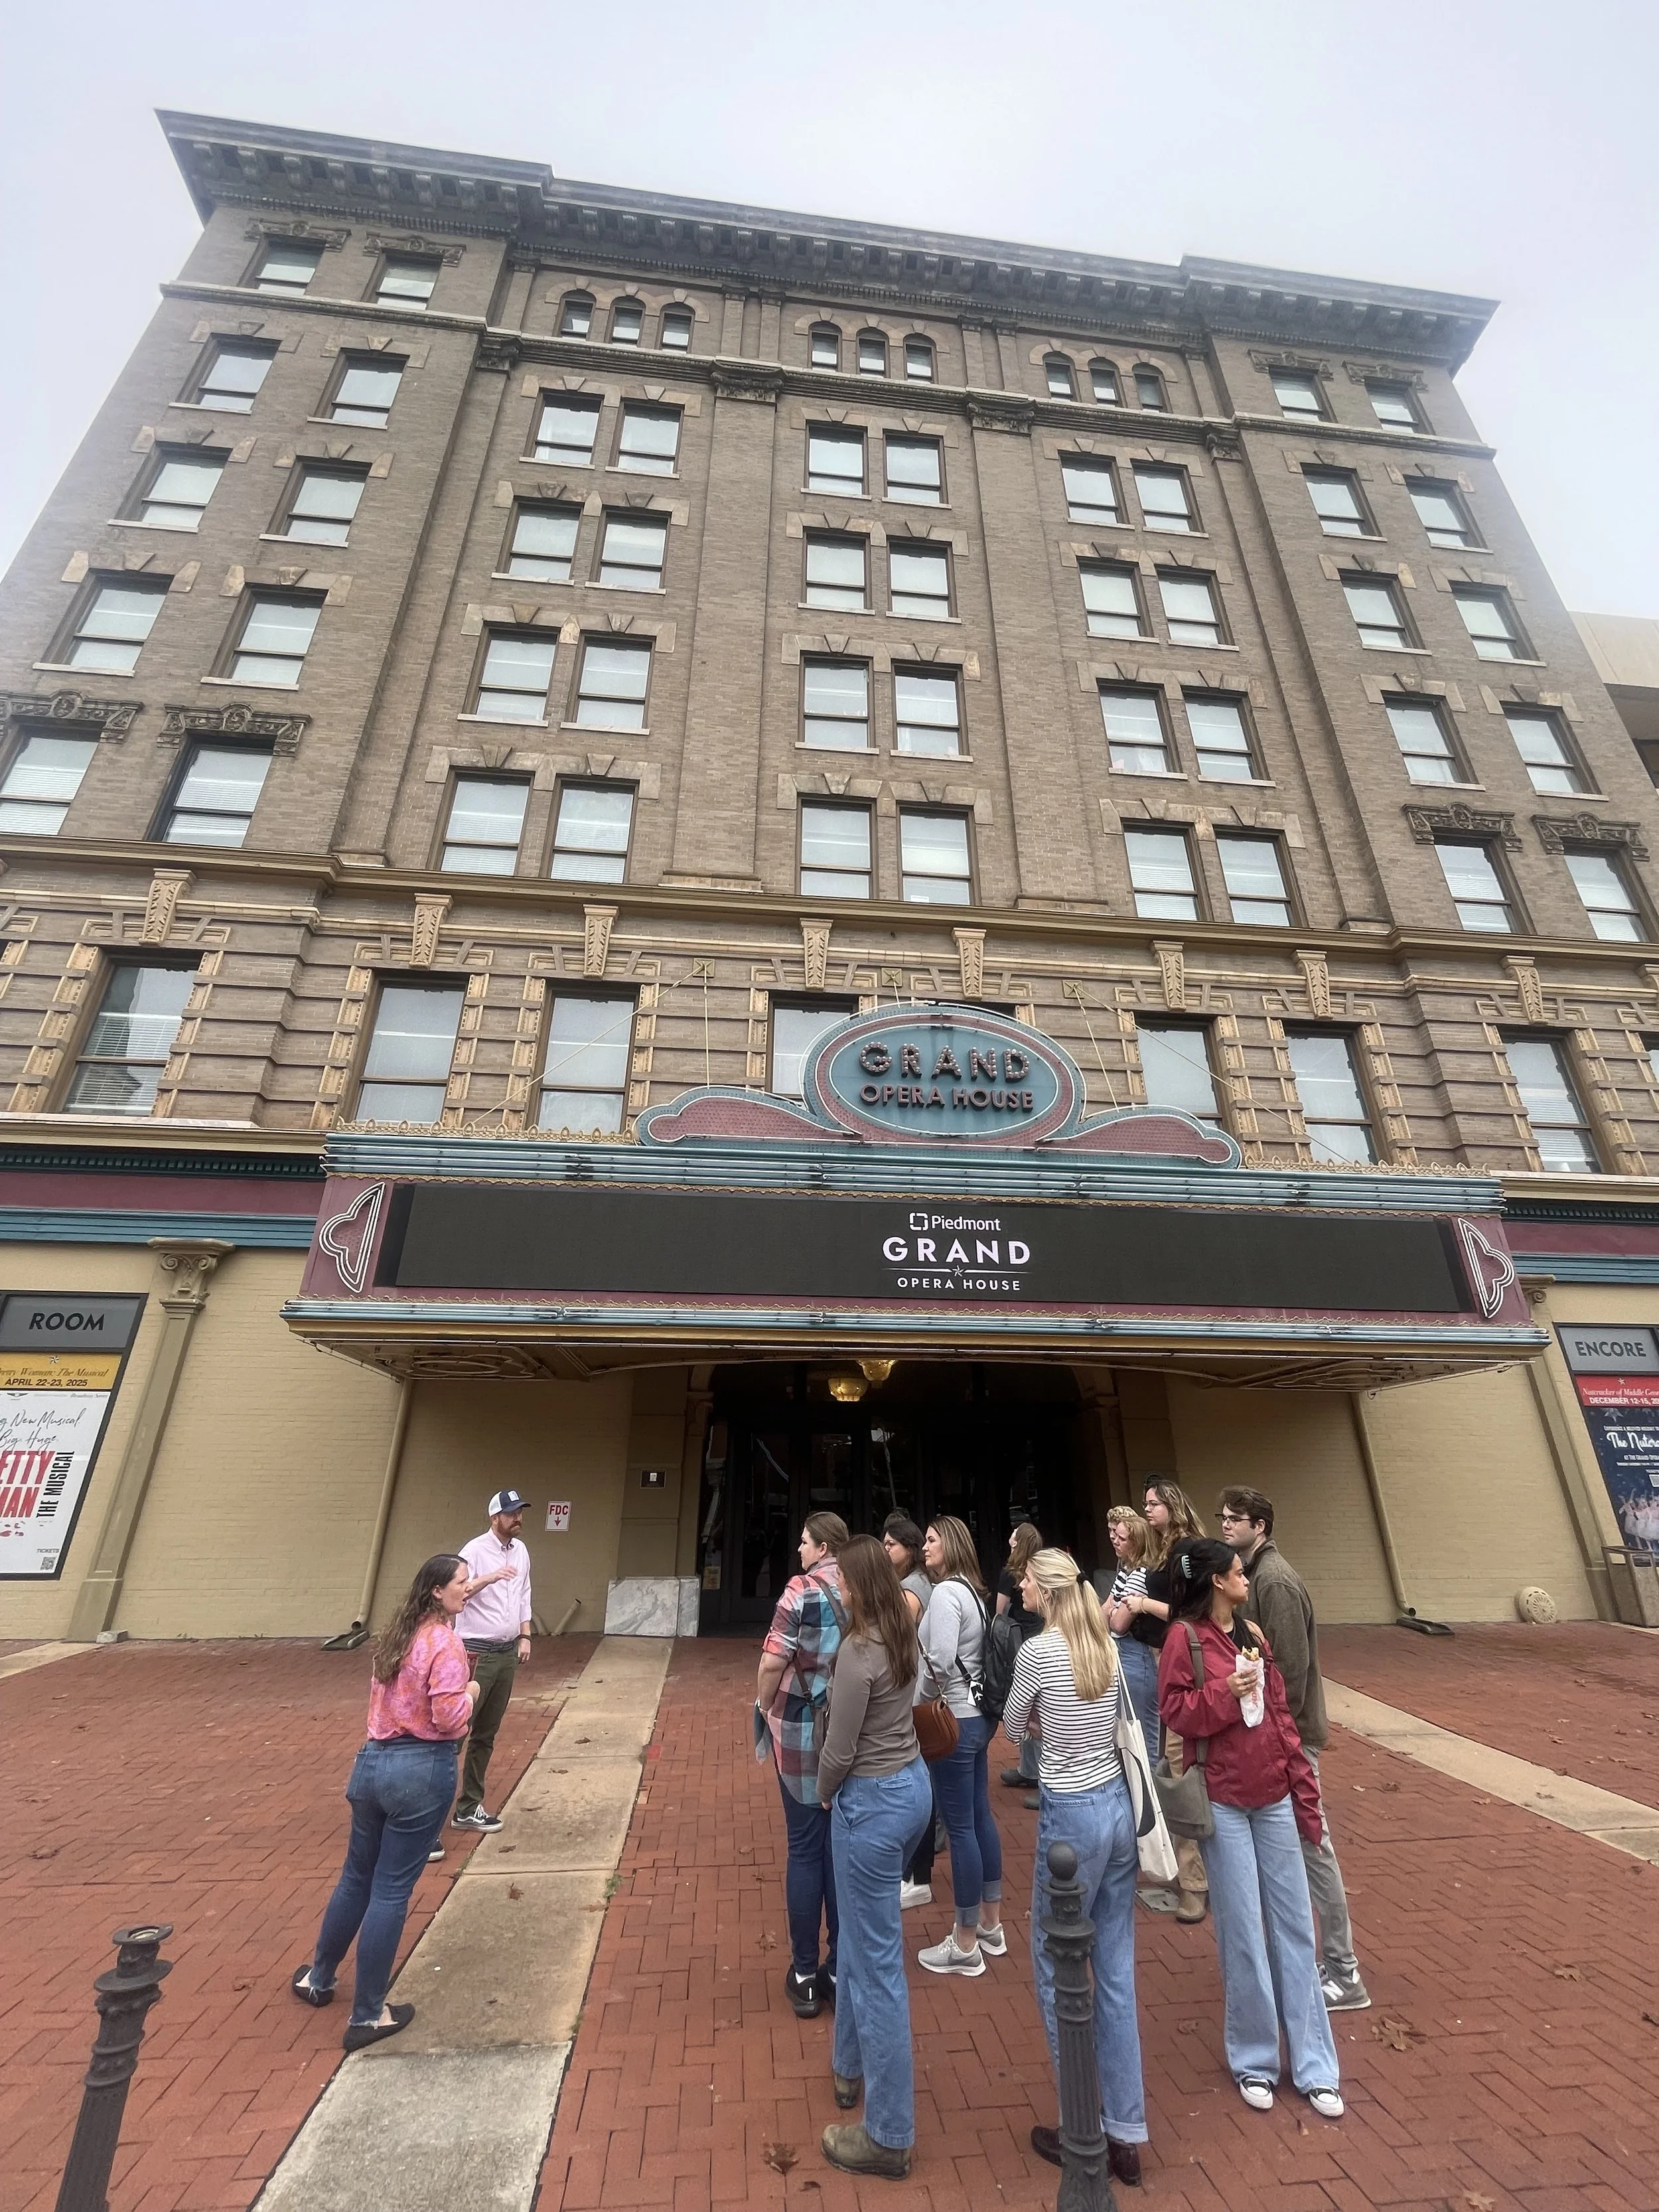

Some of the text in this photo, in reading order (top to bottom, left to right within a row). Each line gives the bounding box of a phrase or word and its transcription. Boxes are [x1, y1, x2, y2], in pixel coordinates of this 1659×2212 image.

[860, 1042, 1031, 1081] GRAND
[861, 1085, 1034, 1112] OPERA HOUSE
[932, 1215, 1001, 1231] Piedmont
[883, 1236, 1031, 1264] GRAND
[897, 1278, 1020, 1291] OPERA HOUSE
[29, 1312, 105, 1331] ROOM
[1575, 1341, 1646, 1357] ENCORE
[10, 1409, 37, 1427] New
[1607, 1432, 1628, 1448] The
[36, 1451, 75, 1518] THE MUSICAL
[549, 1505, 569, 1515] FDC
